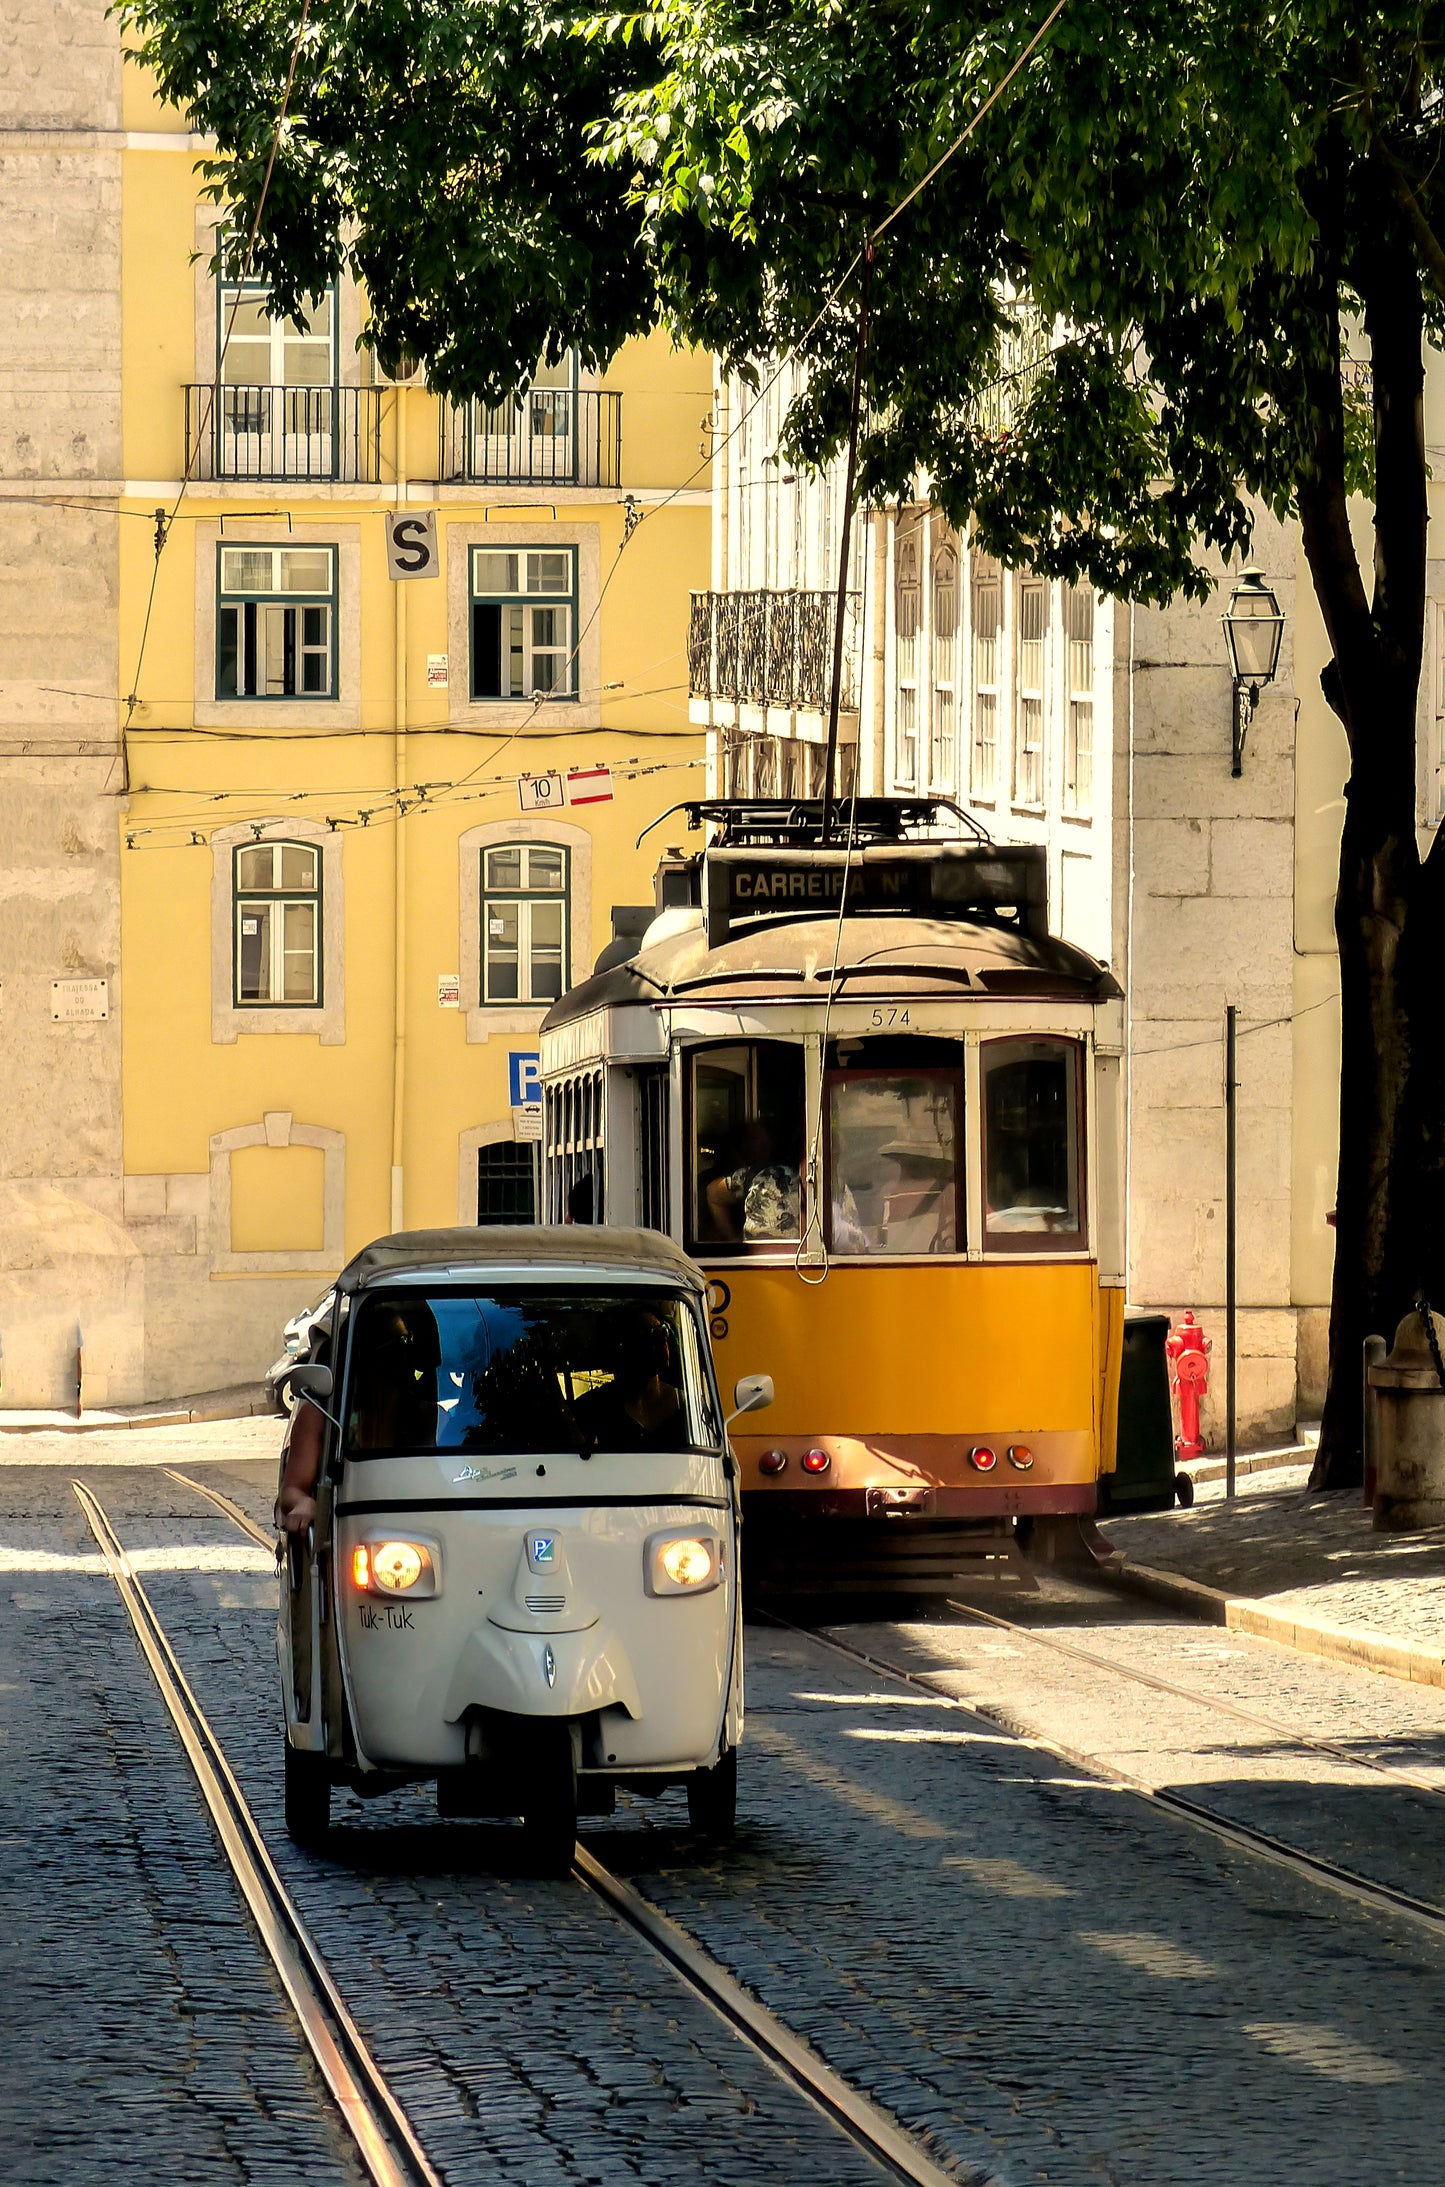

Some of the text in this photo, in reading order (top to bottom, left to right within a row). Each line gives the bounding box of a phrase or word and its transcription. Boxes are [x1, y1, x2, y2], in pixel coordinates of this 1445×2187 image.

[393, 520, 430, 571] S
[530, 779, 551, 798] 10
[735, 872, 866, 898] CARREIRA
[871, 1008, 911, 1027] 574
[519, 1060, 541, 1100] P
[358, 1605, 415, 1630] Tuk-Tuk
